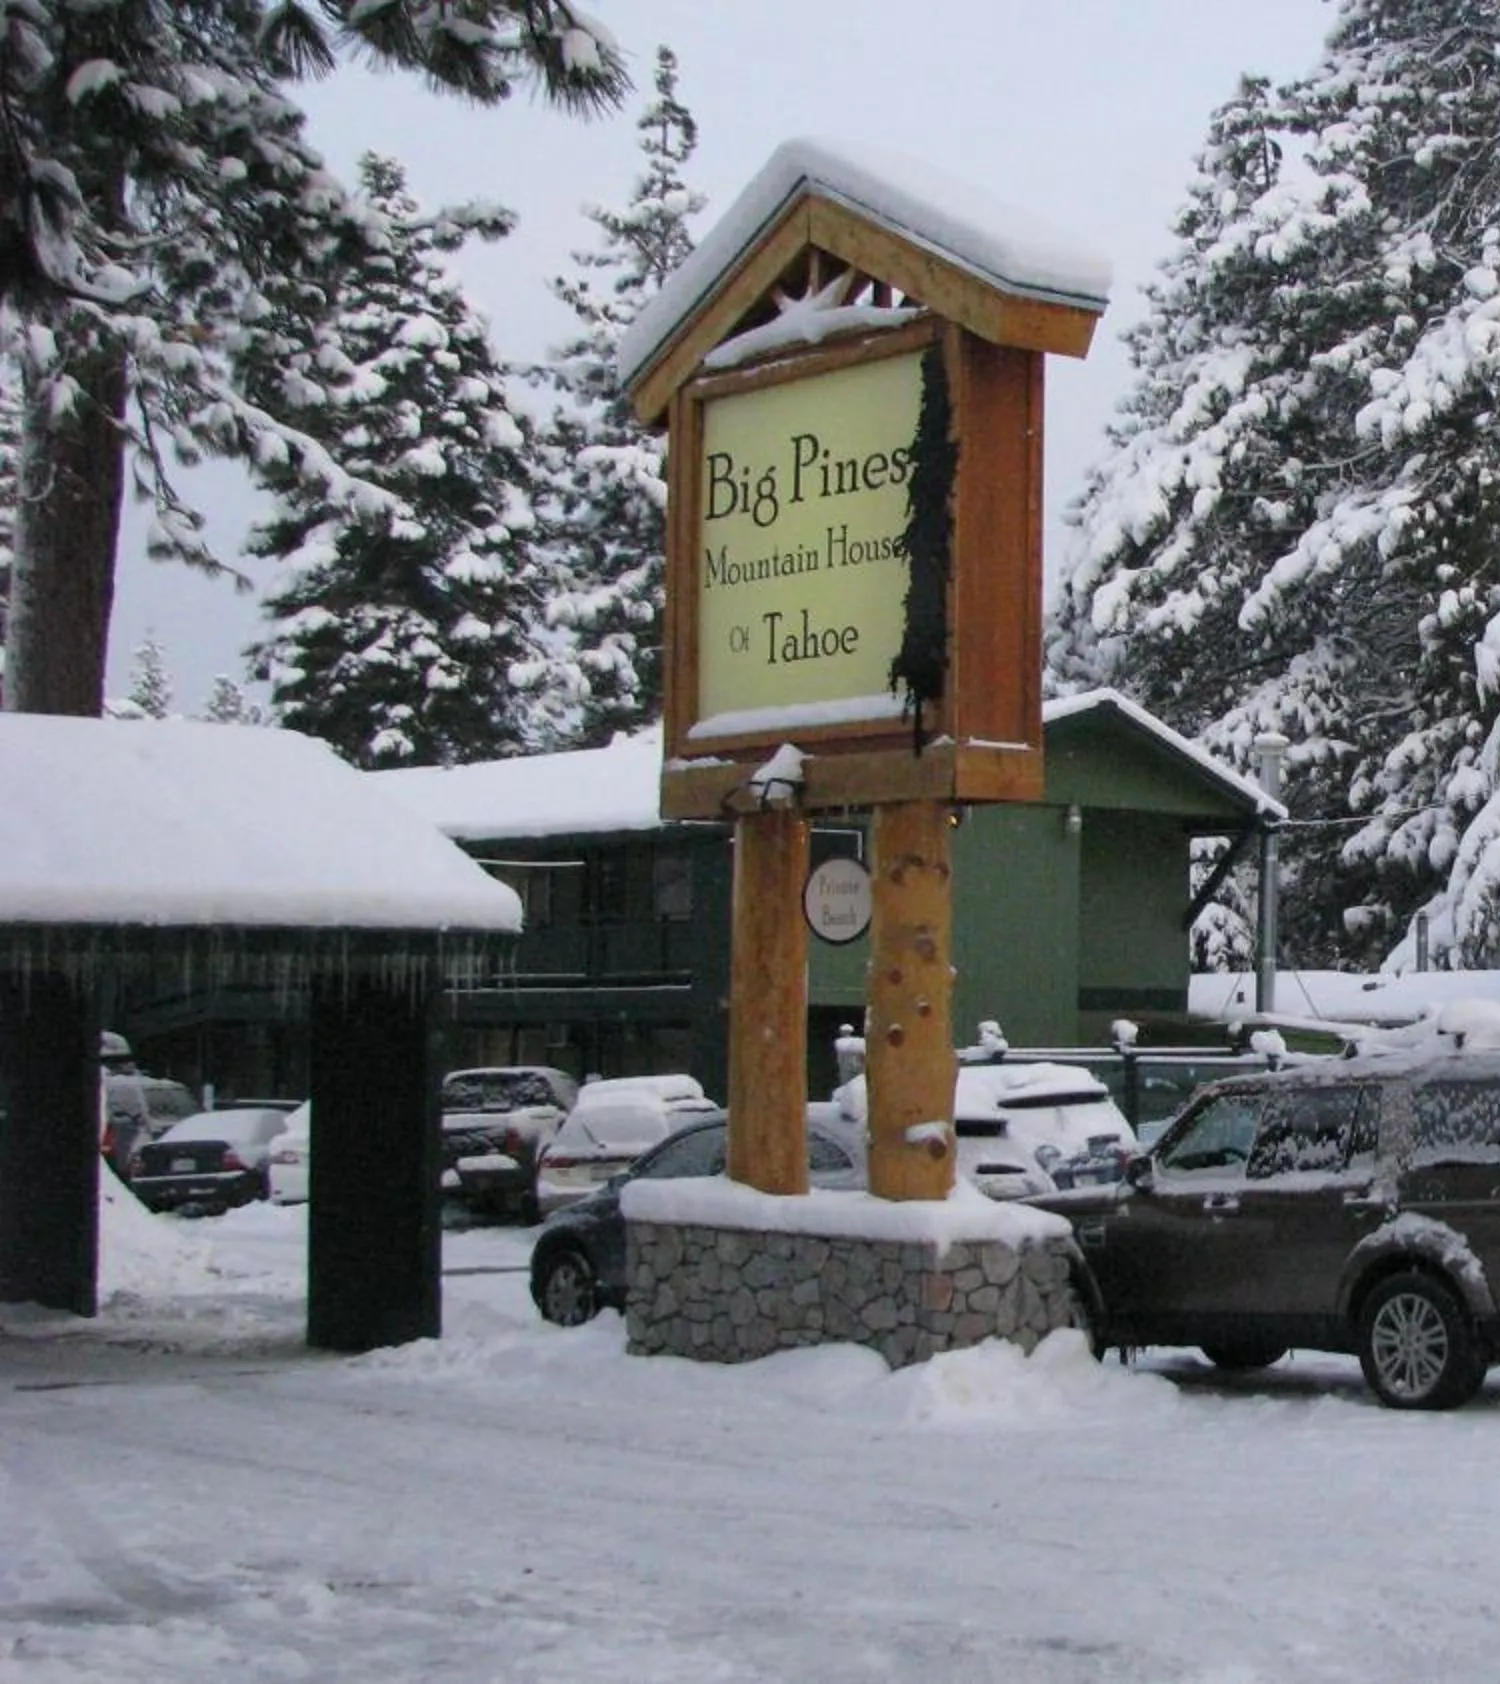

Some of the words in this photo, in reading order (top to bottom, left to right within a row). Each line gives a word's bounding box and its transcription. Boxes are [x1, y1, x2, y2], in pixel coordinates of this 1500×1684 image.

[704, 452, 779, 527] Big
[788, 432, 908, 504] Pines
[703, 543, 819, 589] Mountain
[826, 524, 907, 568] House
[762, 608, 859, 664] Tahoe
